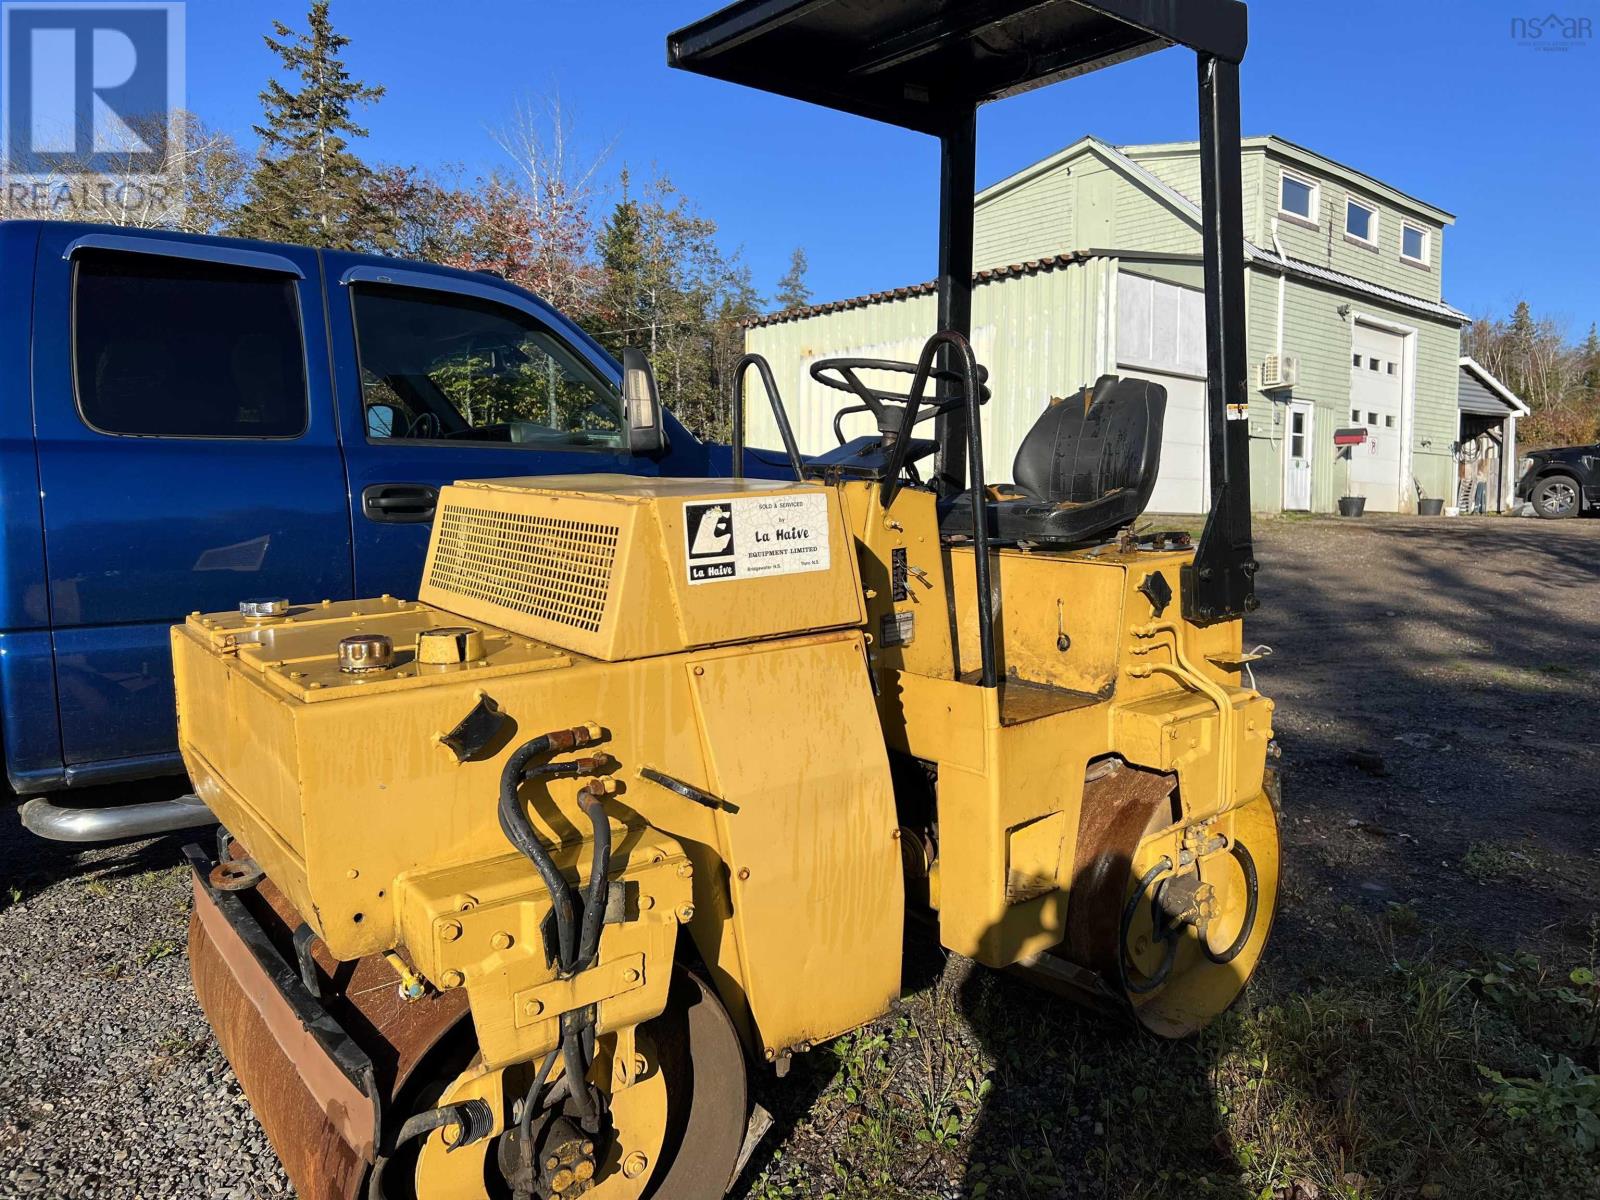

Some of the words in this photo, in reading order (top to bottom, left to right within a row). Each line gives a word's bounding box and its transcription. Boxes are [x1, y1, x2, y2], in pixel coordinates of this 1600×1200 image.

[755, 531, 770, 542] La
[776, 527, 810, 540] Haive
[748, 549, 788, 558] EQUIPMENT
[790, 546, 818, 554] LIMITED
[693, 568, 704, 578] La
[708, 565, 733, 576] Haive
